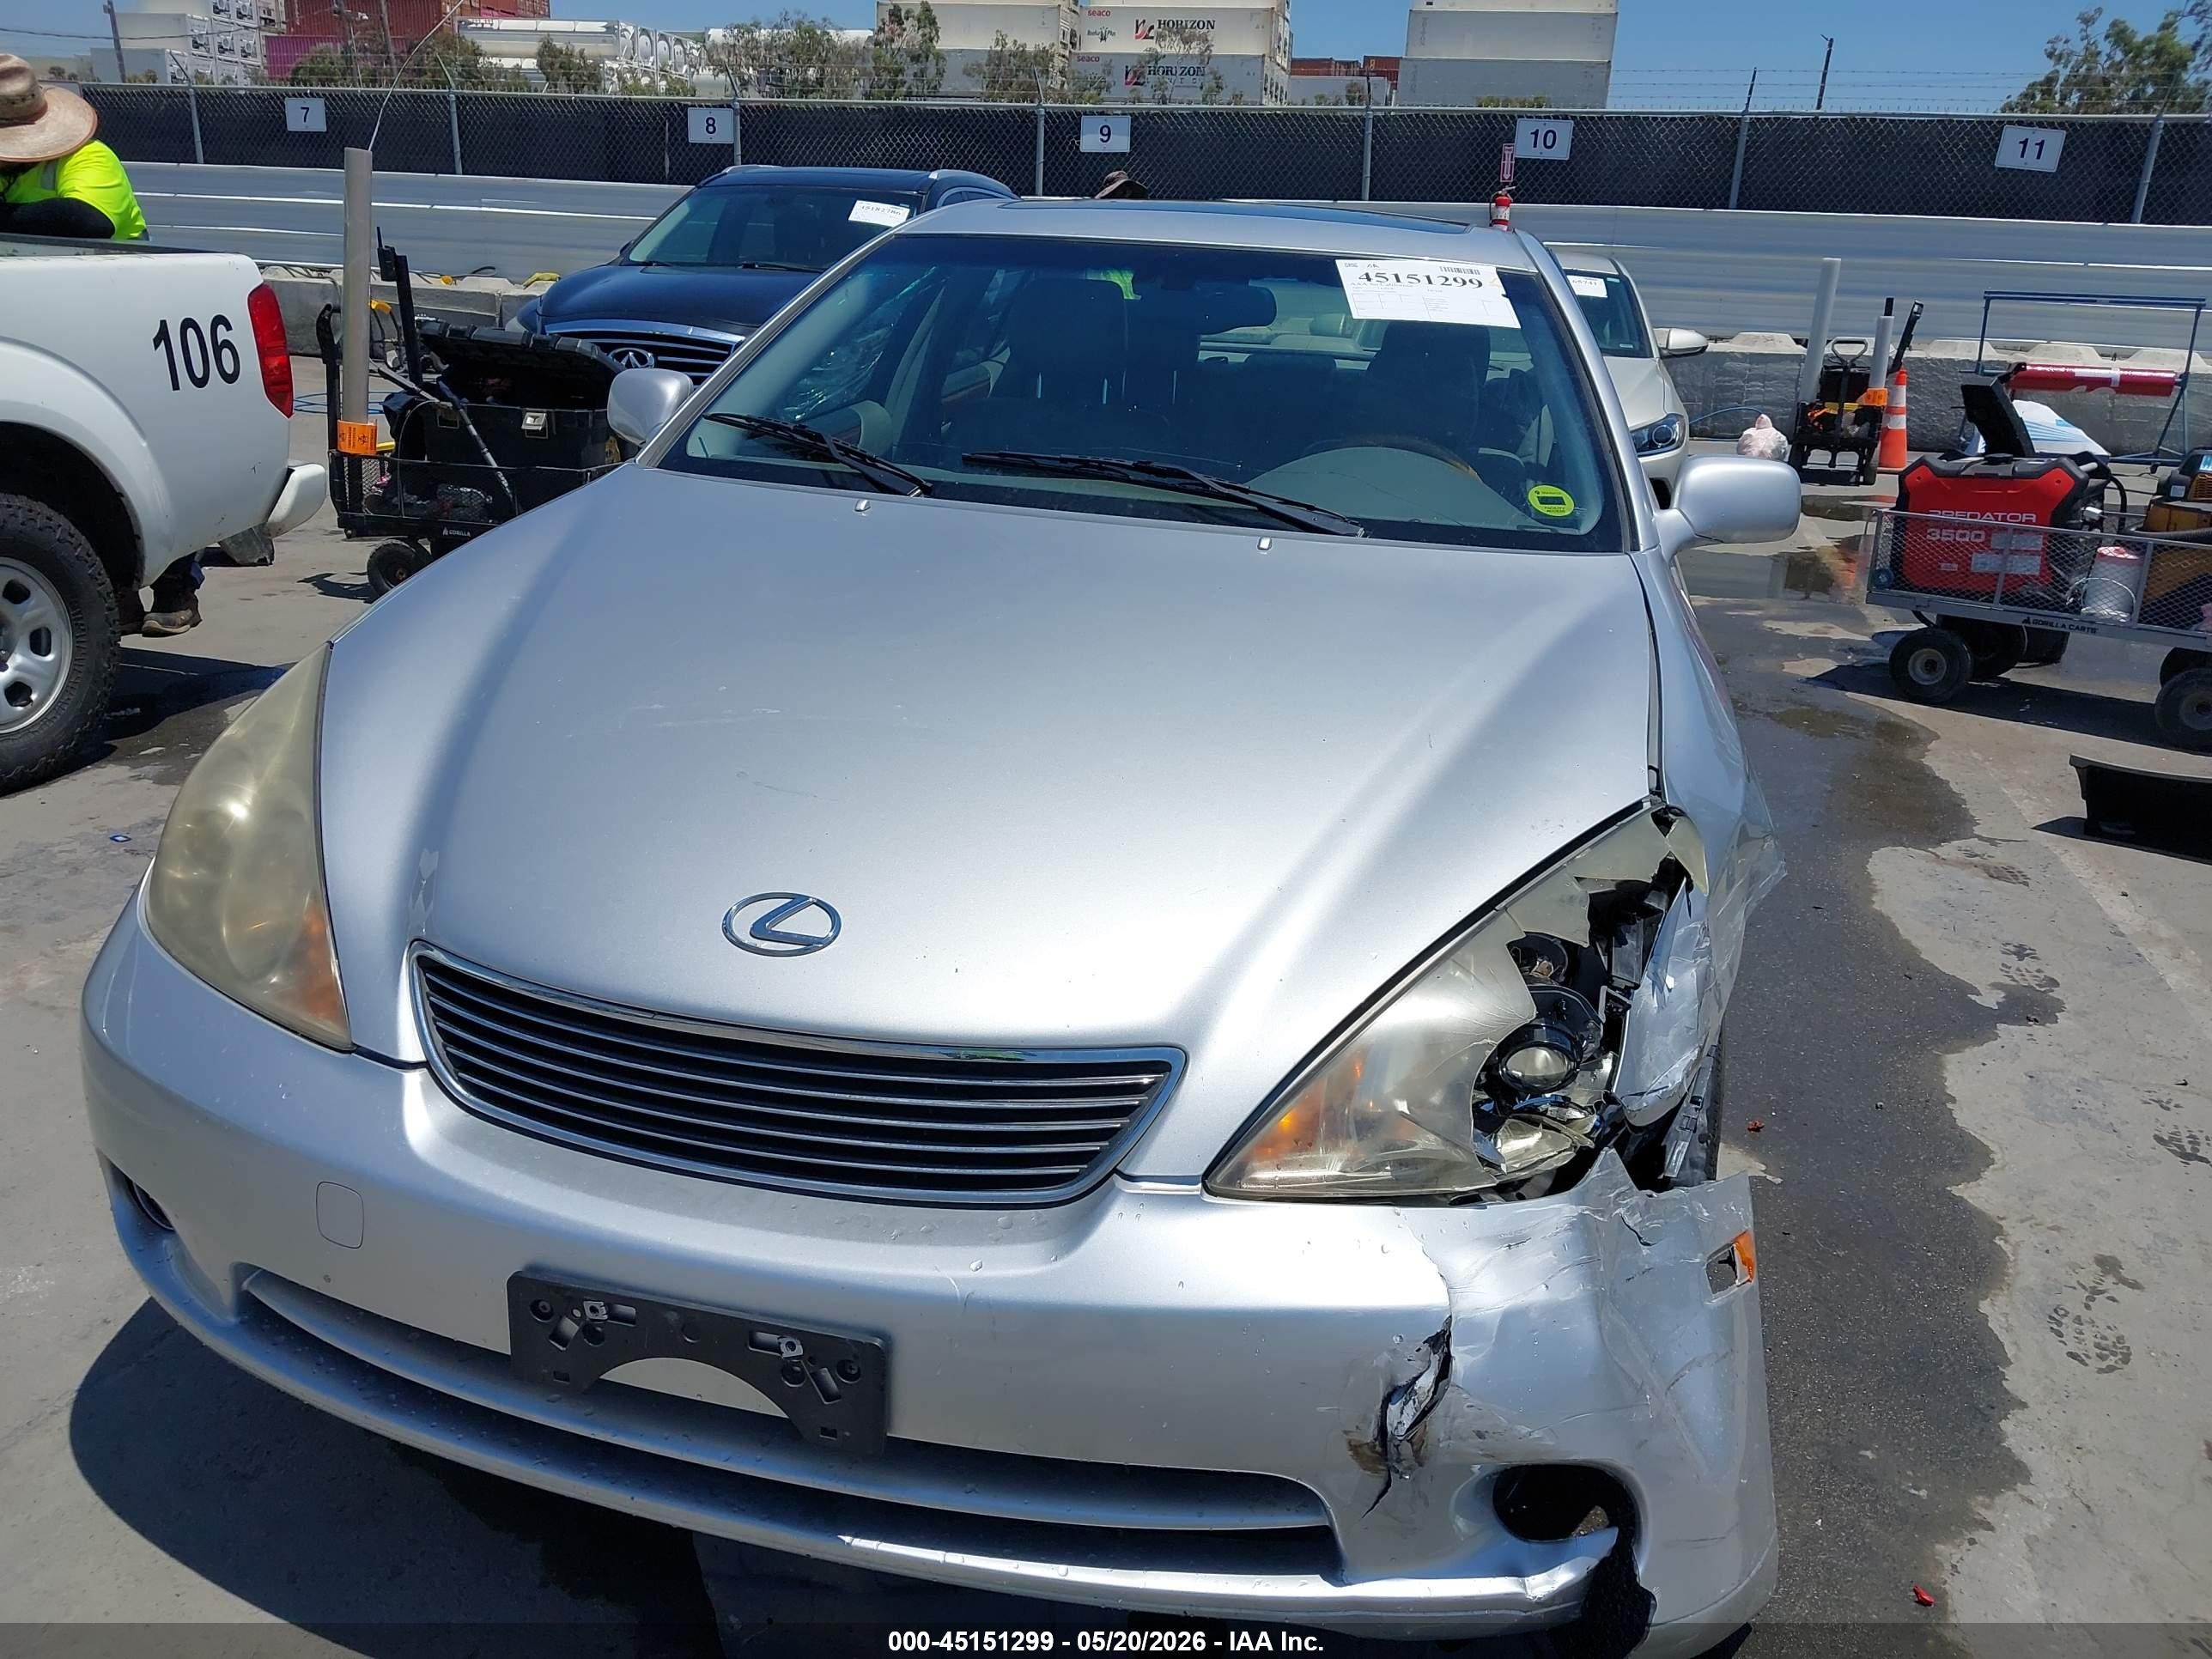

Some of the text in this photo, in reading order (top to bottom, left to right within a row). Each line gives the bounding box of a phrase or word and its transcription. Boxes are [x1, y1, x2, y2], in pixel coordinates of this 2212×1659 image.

[1087, 9, 1111, 17] seaco
[1157, 19, 1216, 30] HORIZON
[1077, 54, 1100, 63] seaco
[1146, 65, 1206, 76] HORIZON
[301, 106, 309, 123] 7
[705, 116, 716, 135] 8
[1099, 125, 1111, 143] 9
[1529, 128, 1557, 149] 10
[2019, 137, 2045, 160] 11
[1358, 271, 1484, 289] 45151299
[152, 313, 240, 392] 106
[1926, 528, 1986, 543] 3500
[2033, 619, 2066, 629] GORILLA
